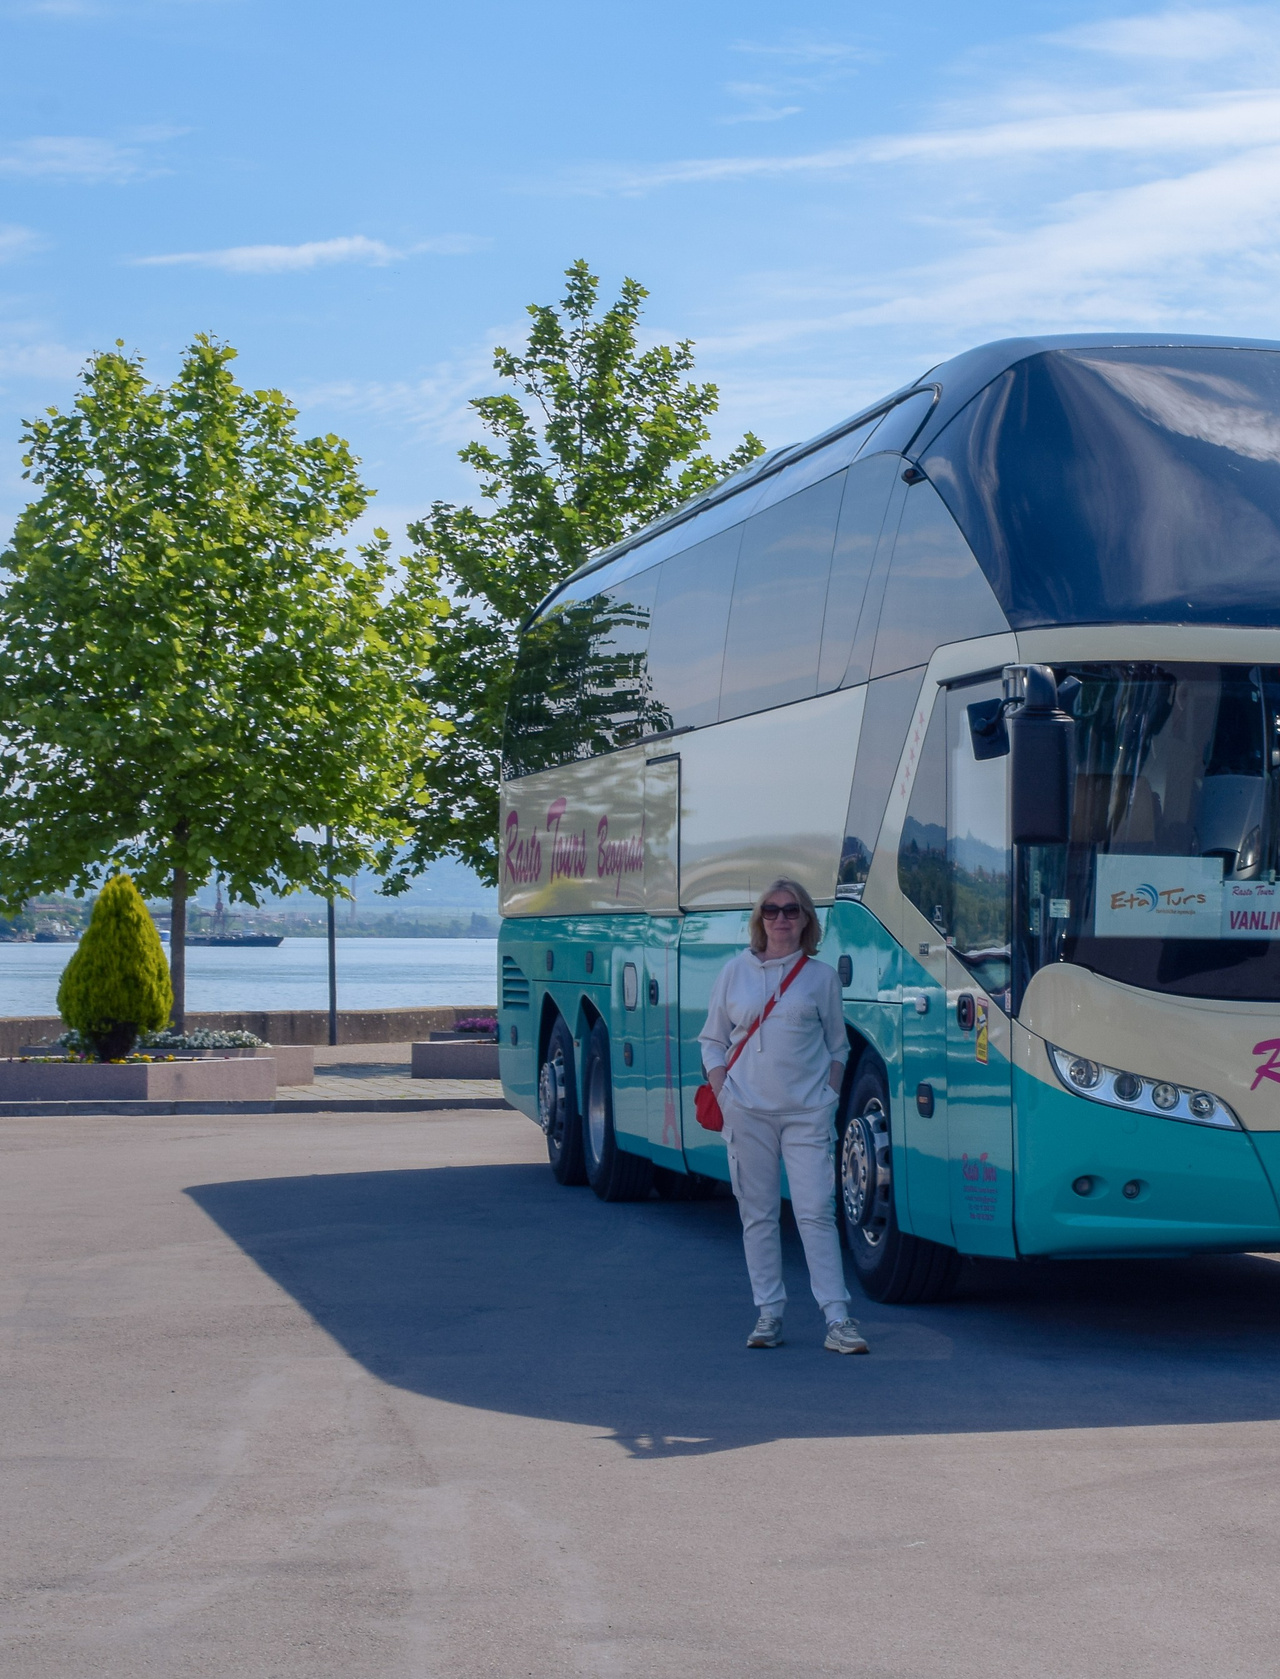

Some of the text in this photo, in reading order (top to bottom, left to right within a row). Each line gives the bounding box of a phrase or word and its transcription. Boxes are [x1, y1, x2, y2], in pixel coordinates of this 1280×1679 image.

[505, 797, 646, 898] Rasto Tours Beograd
[1110, 887, 1207, 910] Eta Turs
[1232, 885, 1276, 896] Rasto Tours
